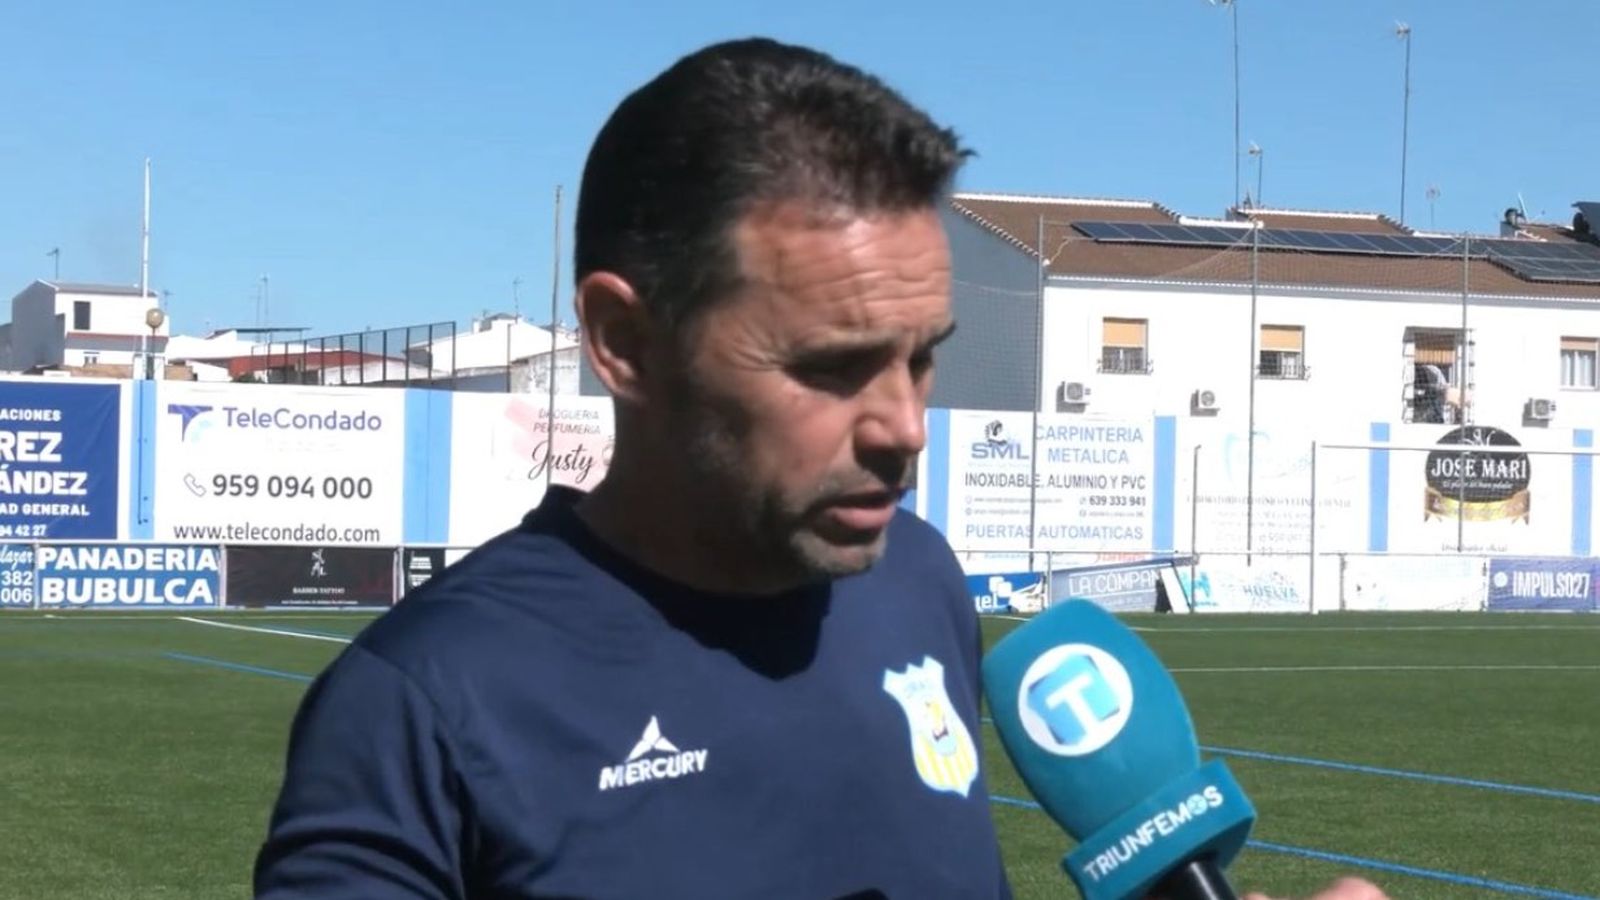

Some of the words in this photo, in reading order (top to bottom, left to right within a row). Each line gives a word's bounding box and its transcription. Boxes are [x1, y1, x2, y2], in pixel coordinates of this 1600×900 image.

[222, 406, 382, 431] TeleCondado
[1036, 424, 1144, 443] CARPINTERIA
[0, 431, 62, 462] REZ
[971, 442, 1030, 460] SML
[1047, 448, 1130, 464] METALICA
[528, 440, 594, 484] Justy
[1431, 458, 1477, 478] JOSE
[1481, 459, 1527, 479] MARI
[212, 474, 260, 497] 959
[267, 475, 315, 498] 094
[322, 476, 374, 499] 000
[1047, 473, 1107, 490] ALUMINIO
[1110, 475, 1119, 489] Y
[1121, 475, 1146, 490] PVC
[22, 503, 90, 516] GENERAL
[1089, 495, 1107, 506] 639
[1109, 495, 1127, 506] 333
[1129, 496, 1146, 507] 941
[15, 524, 30, 537] 42
[32, 524, 47, 537] 27
[173, 522, 381, 543] www.telecondado.com
[966, 523, 1032, 539] PUERTAS
[1038, 524, 1144, 541] AUTOMATICAS
[41, 577, 214, 604] BUBULCA
[1069, 576, 1092, 596] LA
[1513, 570, 1591, 598] IMPULSO27
[598, 749, 708, 791] MERCURY
[1083, 784, 1224, 882] TRIUNFEMOS
